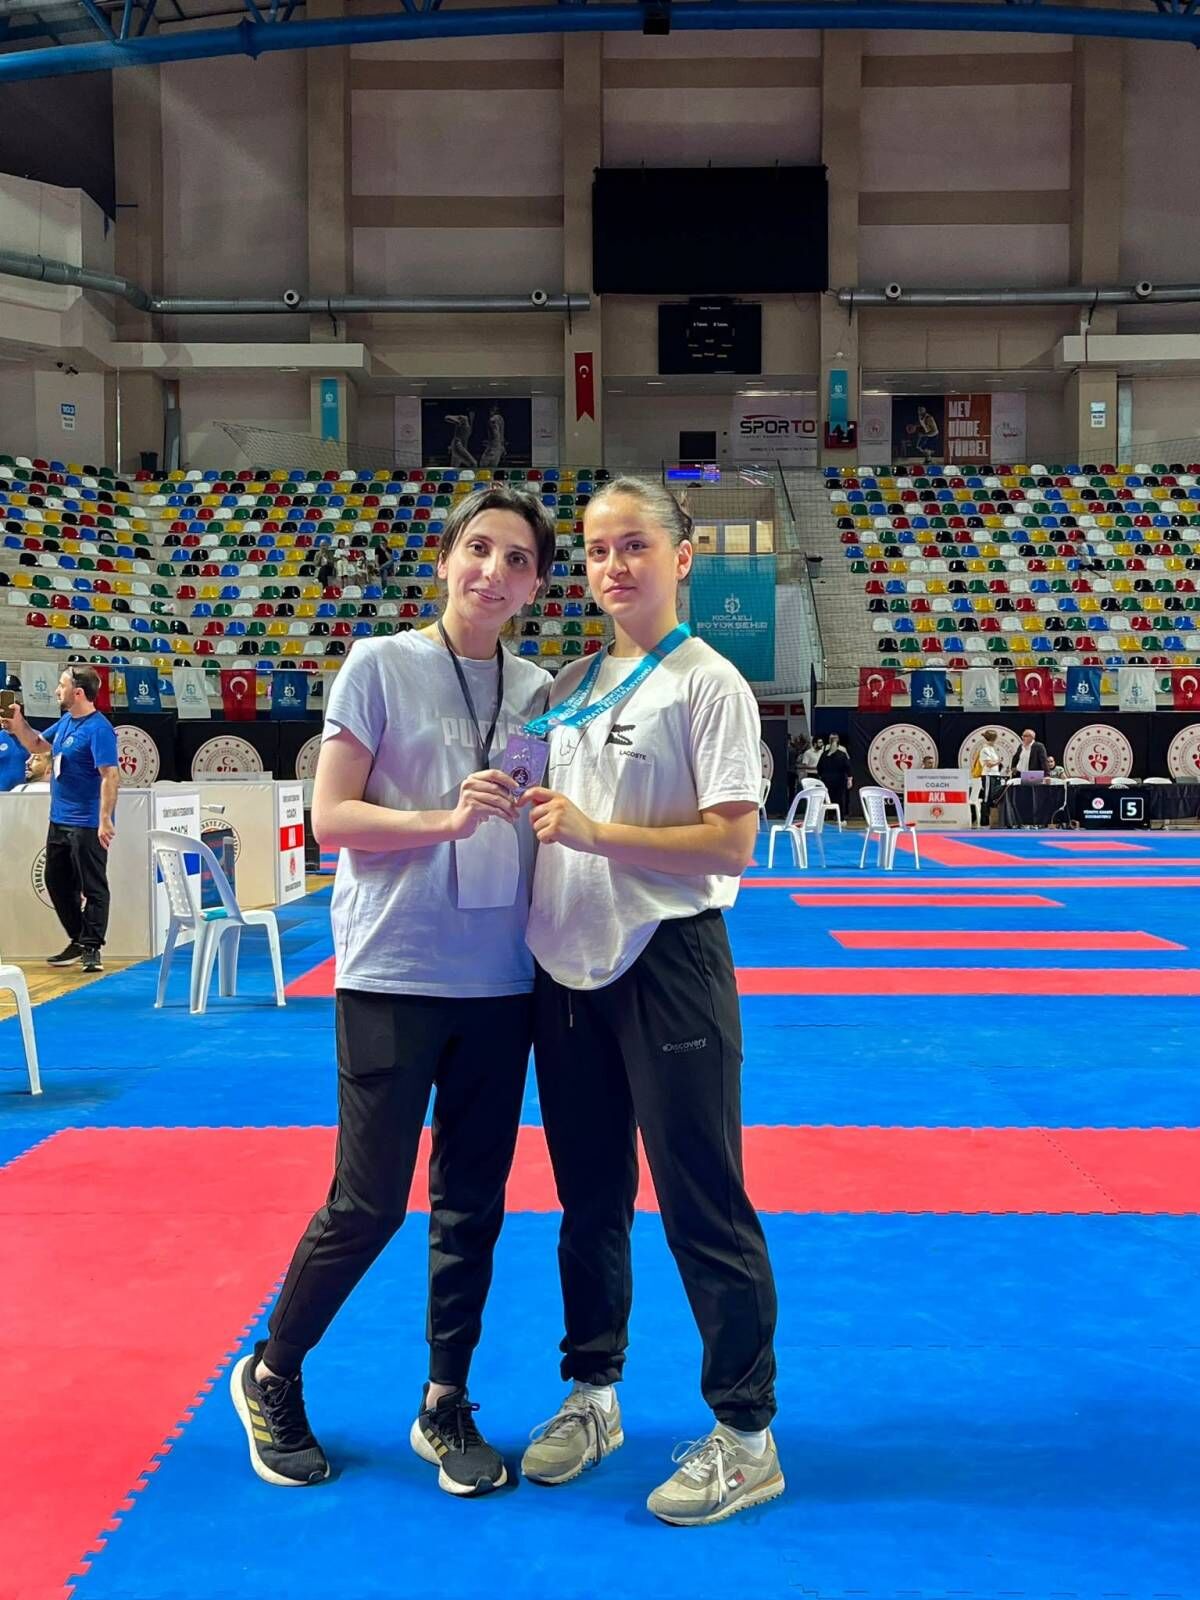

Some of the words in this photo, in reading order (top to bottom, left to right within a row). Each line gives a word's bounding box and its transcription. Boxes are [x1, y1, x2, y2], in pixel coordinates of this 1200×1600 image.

[740, 420, 817, 433] SPORTO
[575, 705, 604, 727] KARATE
[603, 664, 653, 708] FEDERASYONU
[619, 750, 647, 760] LACOSTE
[928, 791, 946, 803] AKA
[1126, 801, 1138, 817] 5
